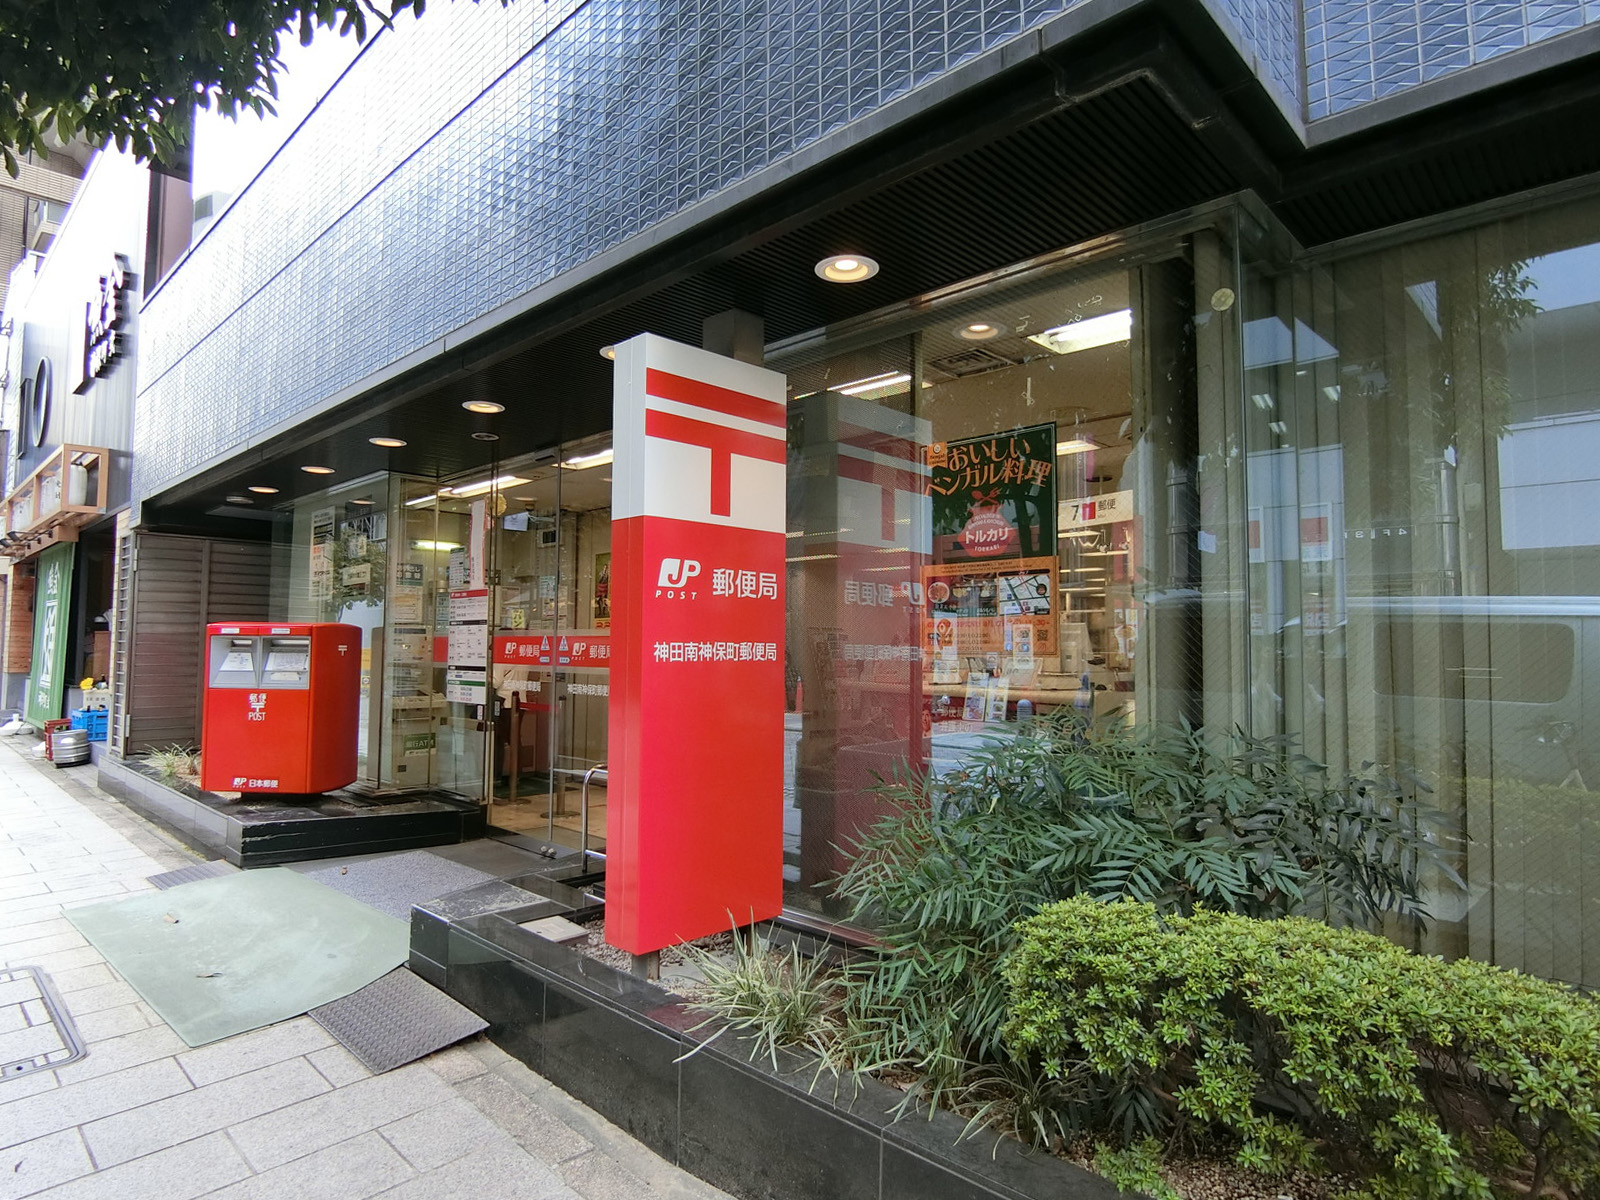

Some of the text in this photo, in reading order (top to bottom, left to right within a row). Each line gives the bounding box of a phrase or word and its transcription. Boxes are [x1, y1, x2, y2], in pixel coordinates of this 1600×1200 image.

[948, 437, 1031, 472] おいしい
[925, 458, 1052, 496] ベンガル料理
[1071, 498, 1117, 521] 7 郵便
[965, 527, 1008, 545] トルカリ
[657, 558, 778, 599] JP 郵便局
[655, 590, 697, 600] POST
[518, 645, 540, 658] 郵便局
[654, 641, 777, 662] 神田南神保町郵便局
[249, 693, 267, 704] 郵便
[248, 712, 266, 721] POST
[249, 779, 279, 788] 日本郵便
